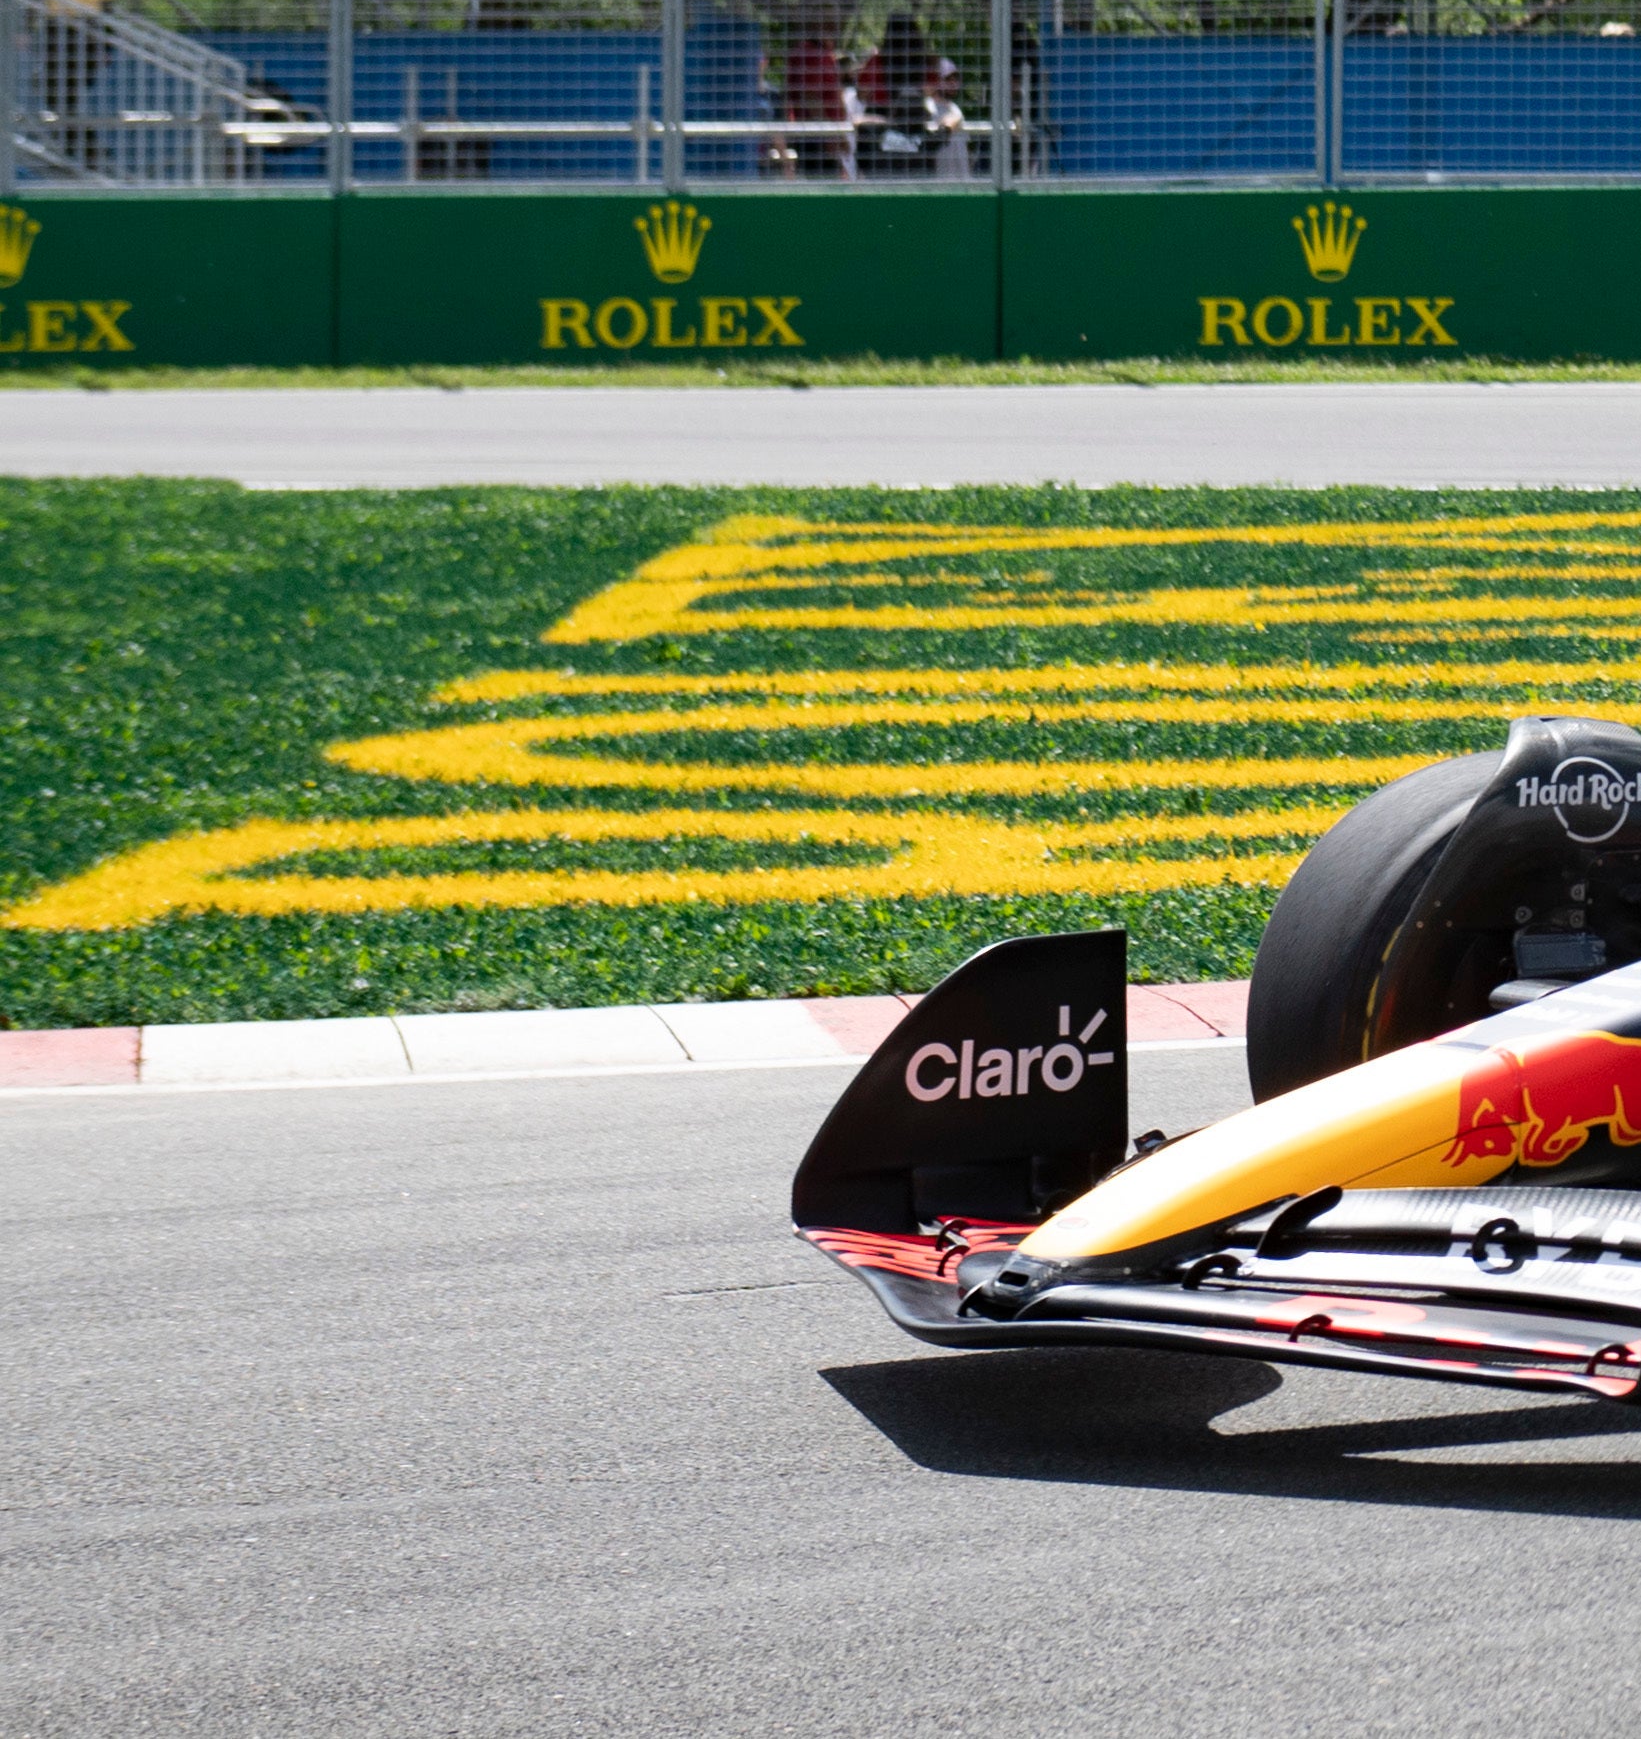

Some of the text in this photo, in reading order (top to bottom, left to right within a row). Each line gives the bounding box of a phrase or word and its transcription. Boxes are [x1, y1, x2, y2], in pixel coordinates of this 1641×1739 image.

[539, 296, 805, 350] ROLEX
[1197, 296, 1458, 347] ROLEX
[1515, 775, 1585, 808] Hard
[905, 1037, 1086, 1103] Claro
